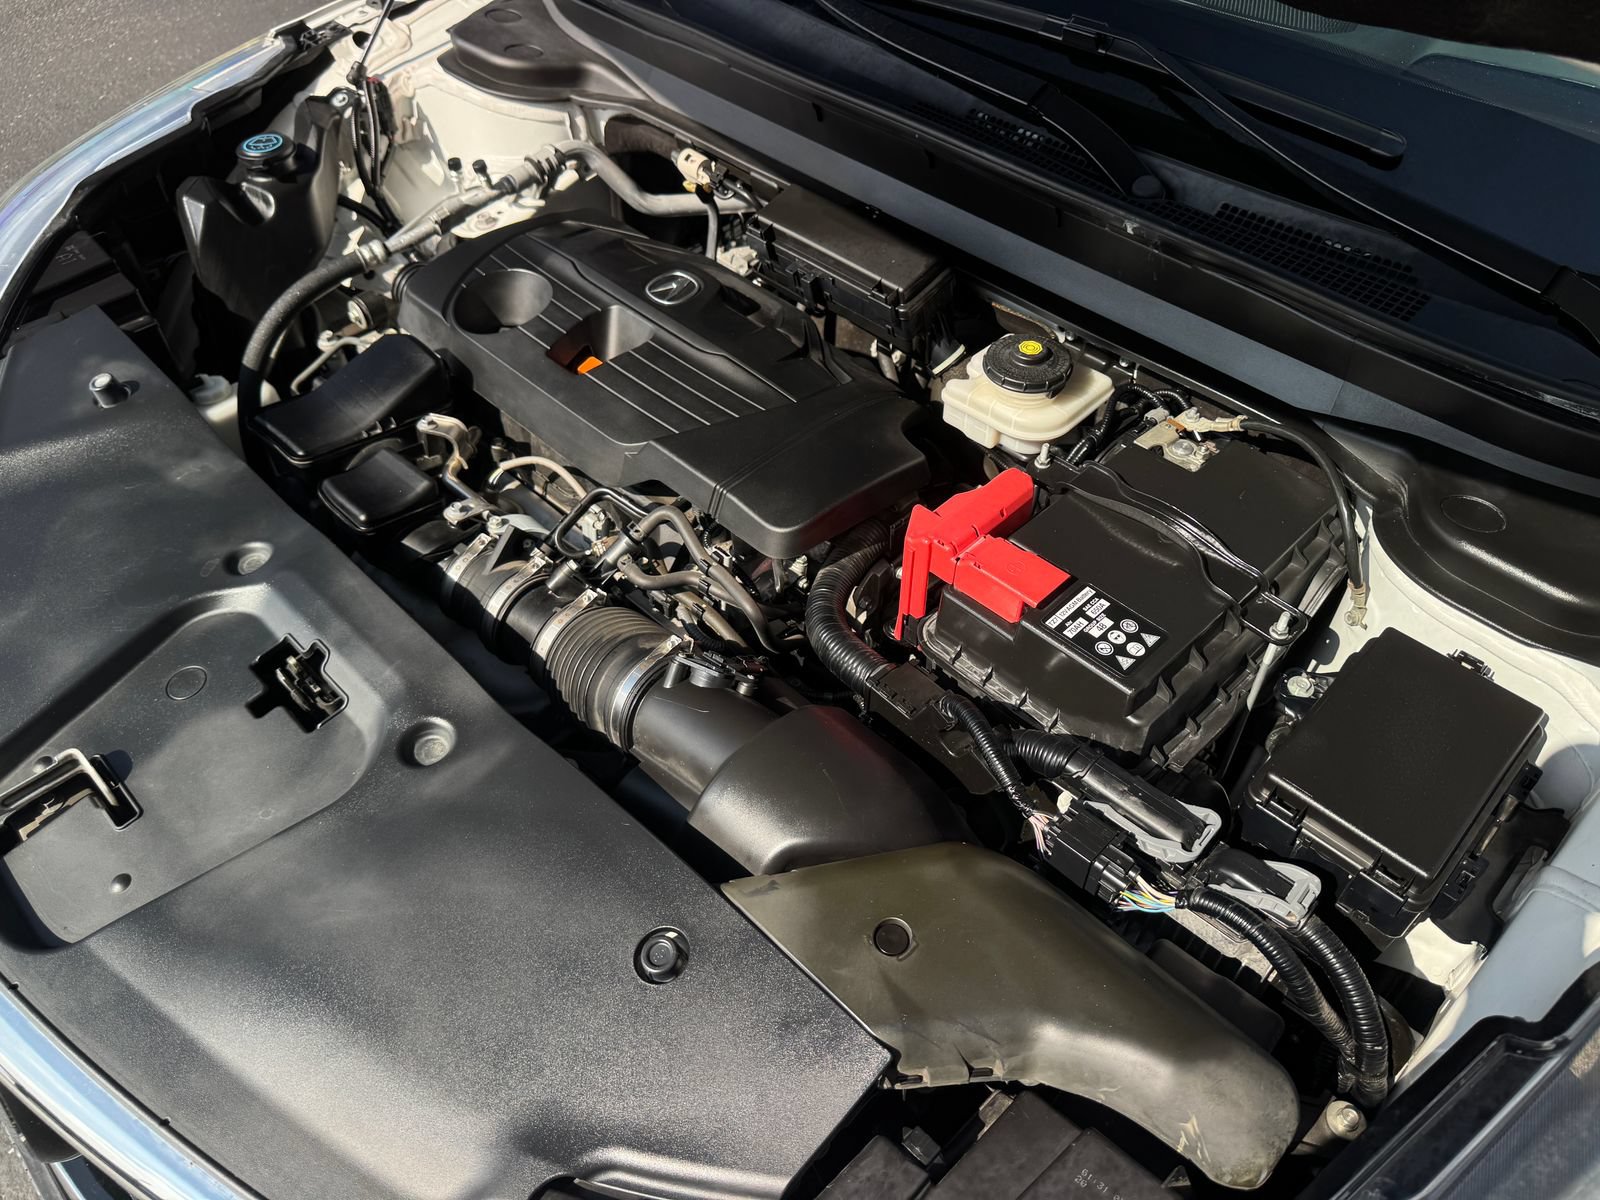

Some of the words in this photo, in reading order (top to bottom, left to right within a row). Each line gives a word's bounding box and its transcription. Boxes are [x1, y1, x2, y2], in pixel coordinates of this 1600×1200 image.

[1075, 588, 1094, 603] Battery
[1067, 621, 1084, 635] 70AH
[1096, 622, 1107, 632] 48
